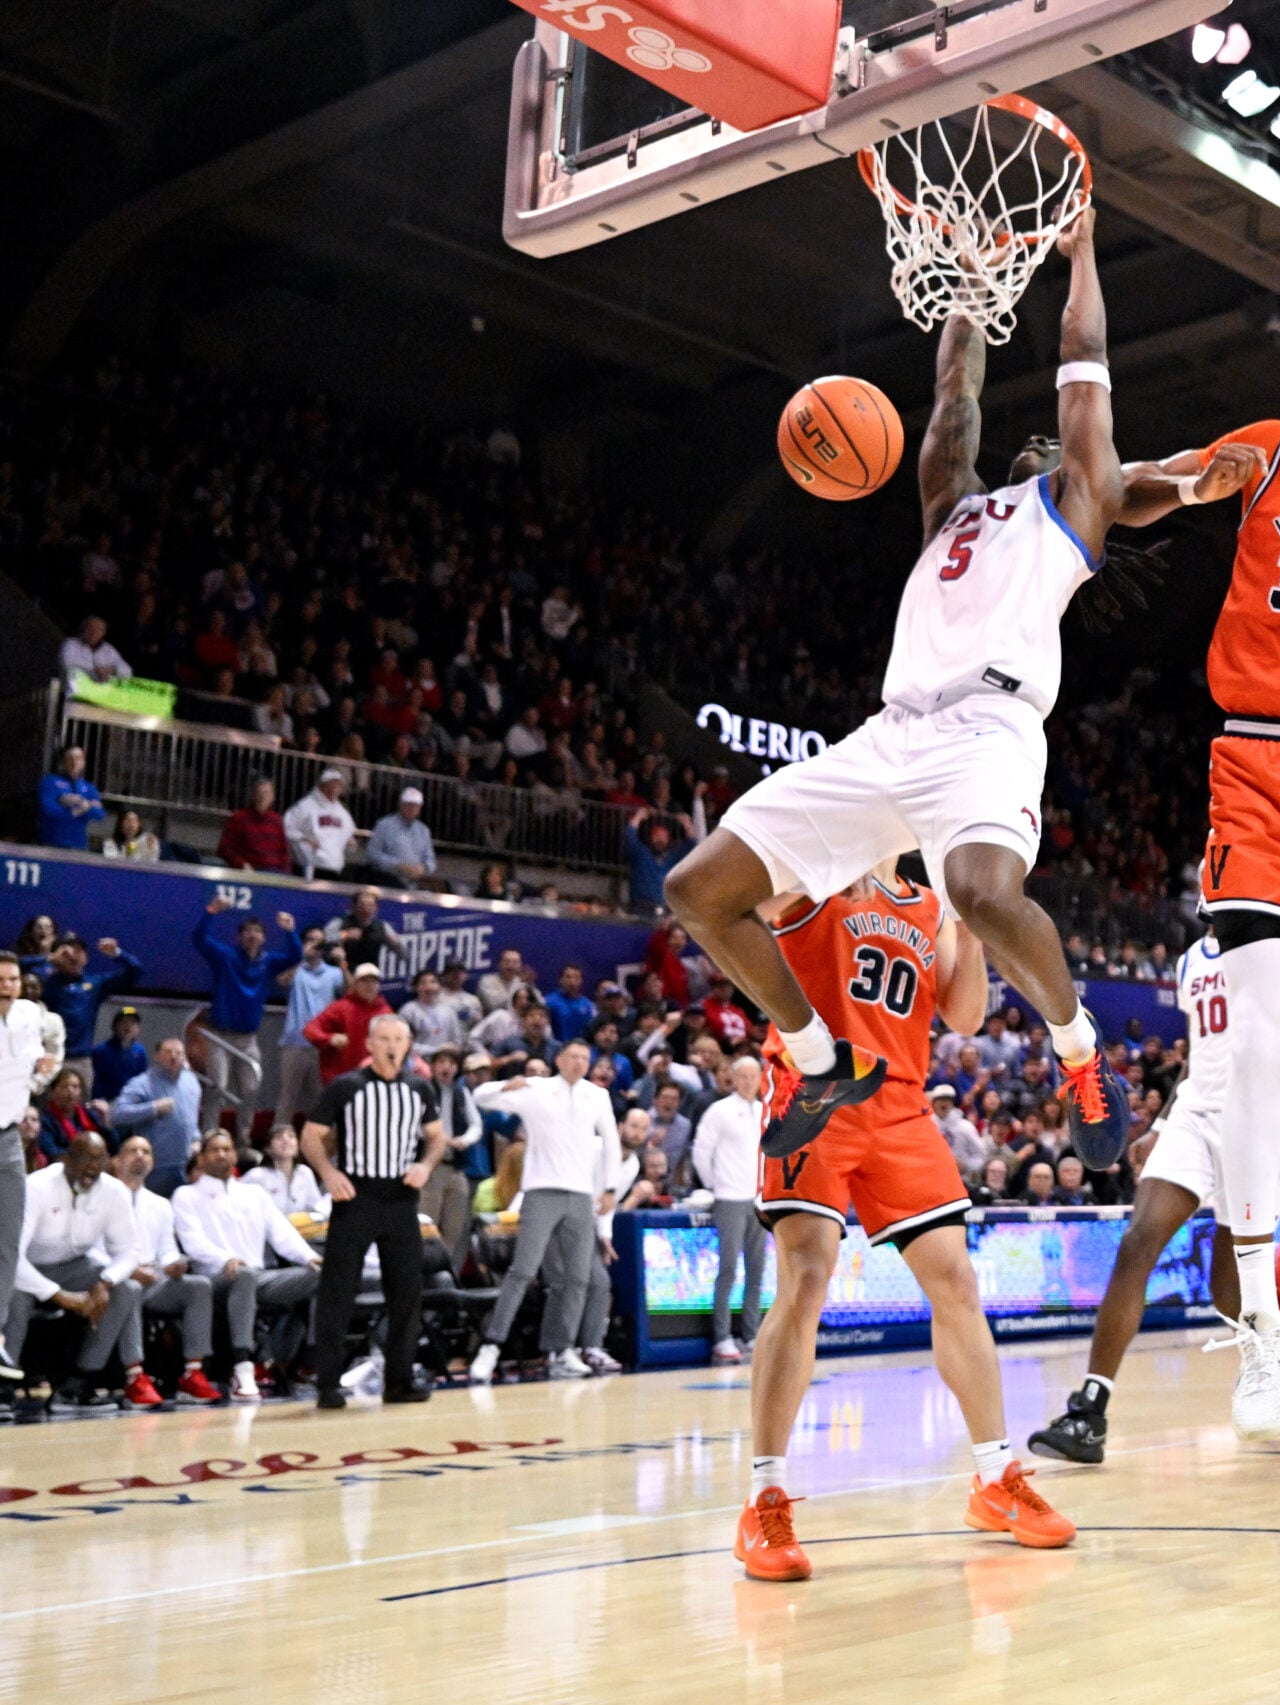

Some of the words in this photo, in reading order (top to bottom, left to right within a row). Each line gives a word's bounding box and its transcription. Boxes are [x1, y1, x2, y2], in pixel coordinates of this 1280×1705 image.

[939, 529, 982, 582] 5
[6, 860, 41, 888] 111
[843, 912, 936, 973] VIRGINIA
[848, 944, 919, 1020] 30
[1196, 995, 1228, 1038] 10
